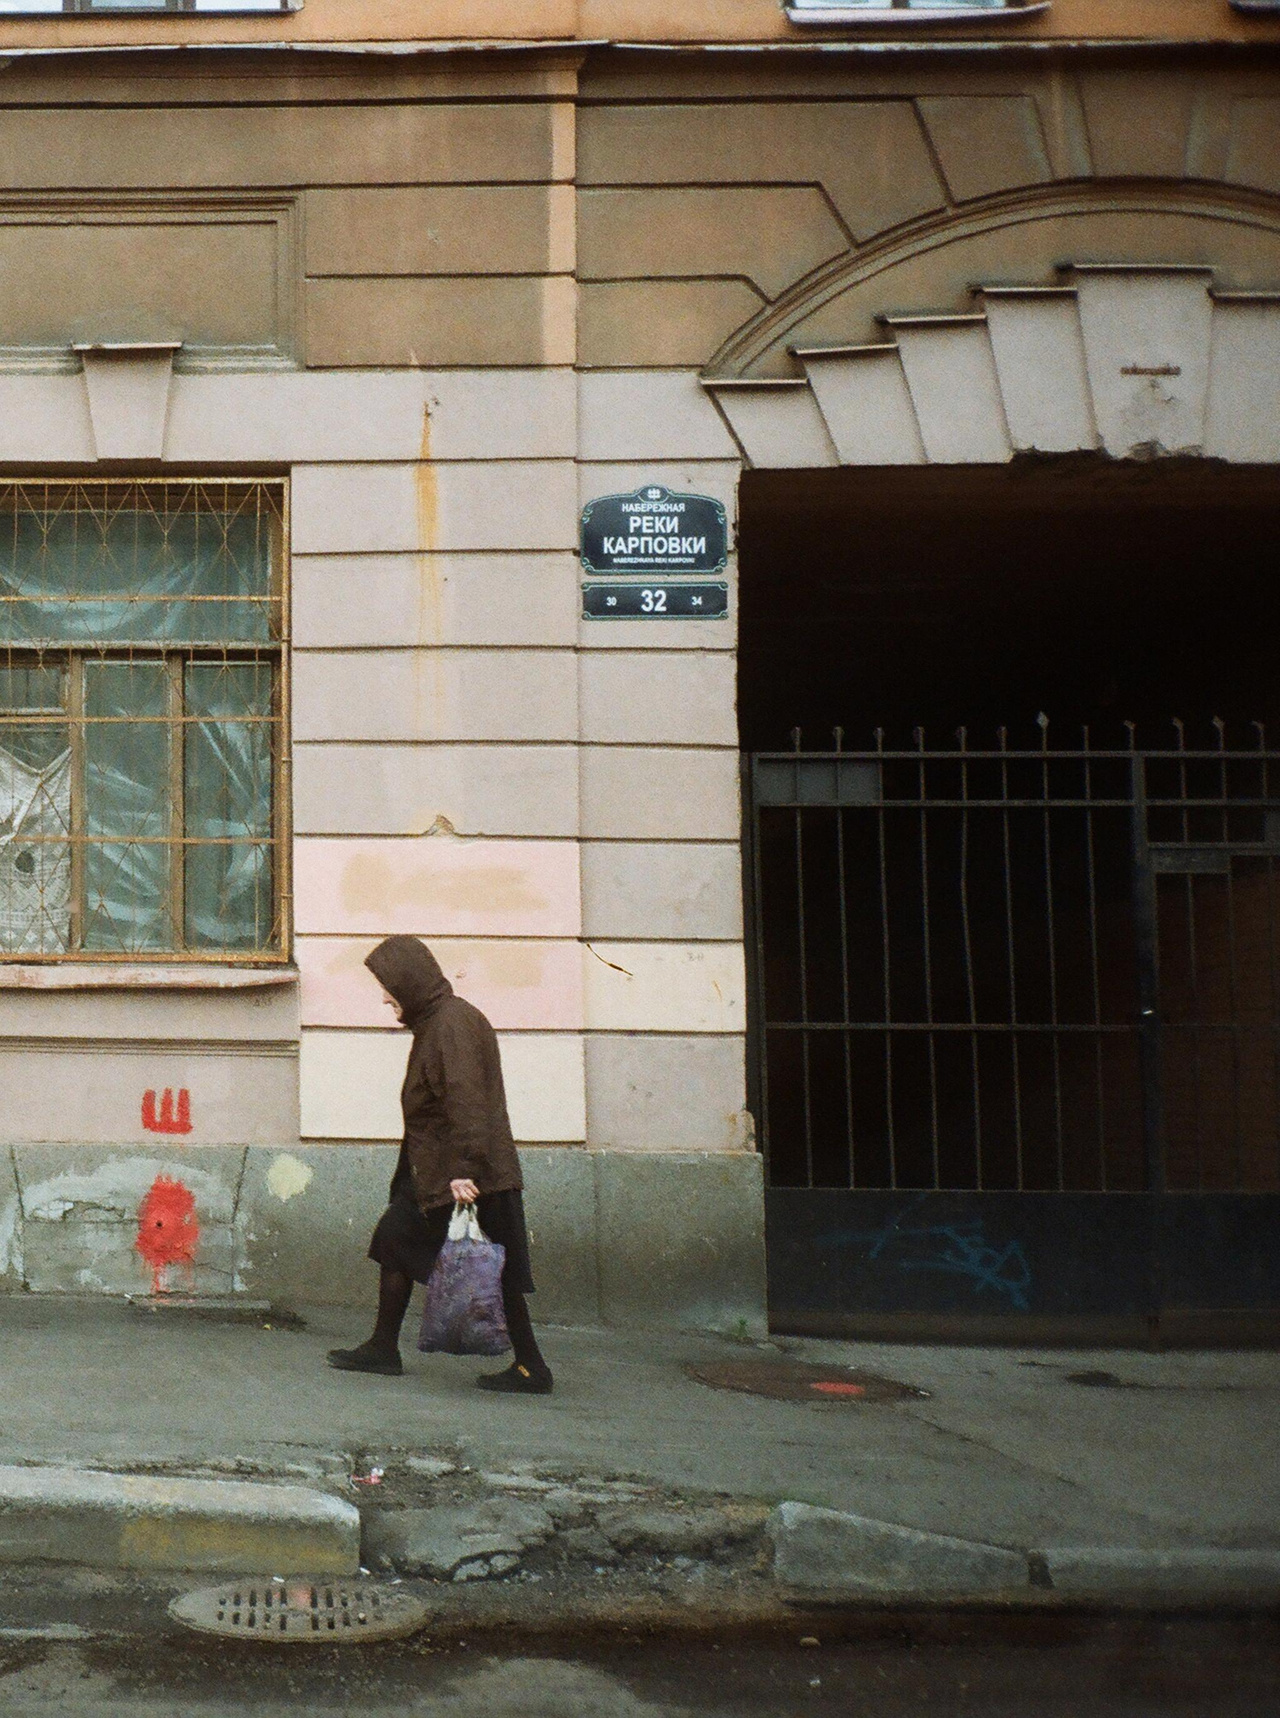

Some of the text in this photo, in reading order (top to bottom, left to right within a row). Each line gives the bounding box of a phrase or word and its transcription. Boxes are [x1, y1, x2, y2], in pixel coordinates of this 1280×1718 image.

[622, 503, 685, 513] НАБЕРЕЖНАЯ
[629, 516, 679, 534] РЕКИ
[603, 536, 706, 554] КАРПОВКИ
[606, 590, 702, 612] 30 32 34
